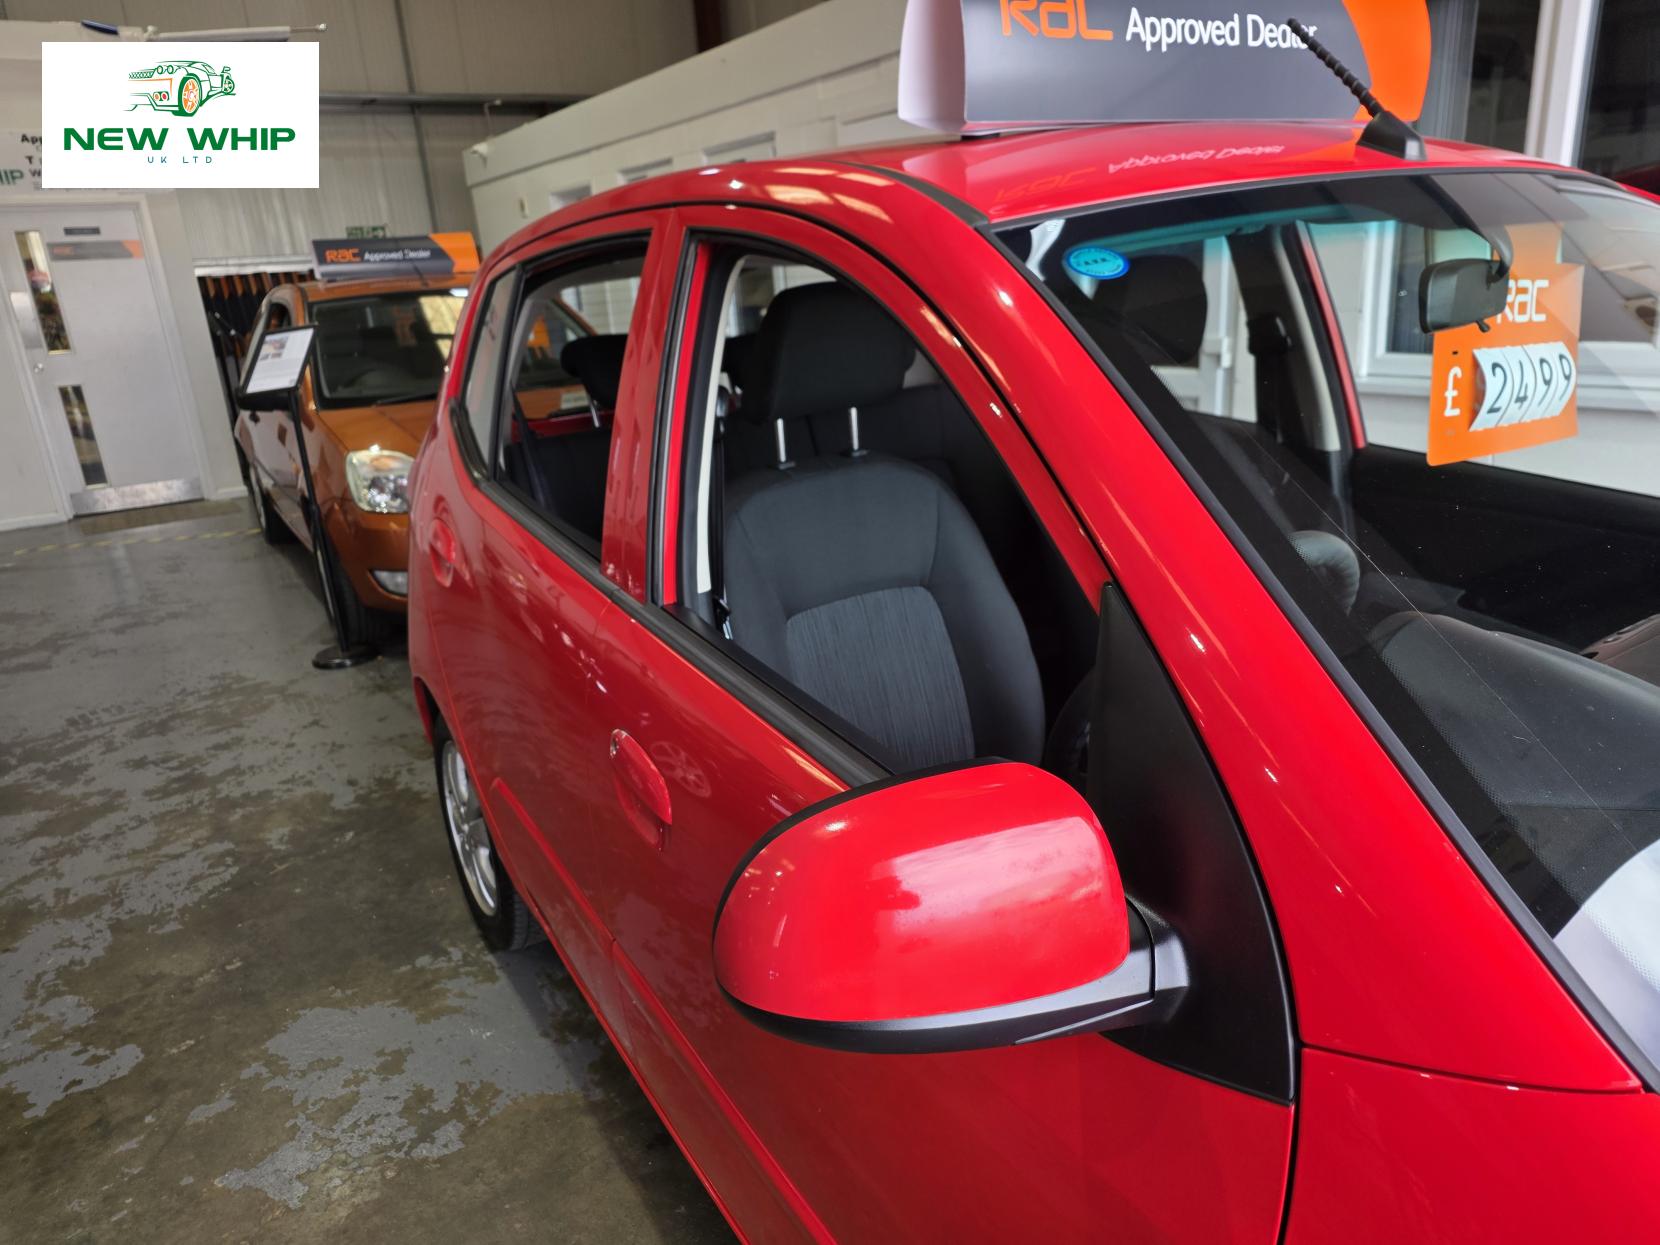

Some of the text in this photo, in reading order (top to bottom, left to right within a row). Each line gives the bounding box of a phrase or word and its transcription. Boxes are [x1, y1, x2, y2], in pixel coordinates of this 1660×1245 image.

[1126, 7, 1240, 52] Approved
[1443, 353, 1573, 417] £ 2499
